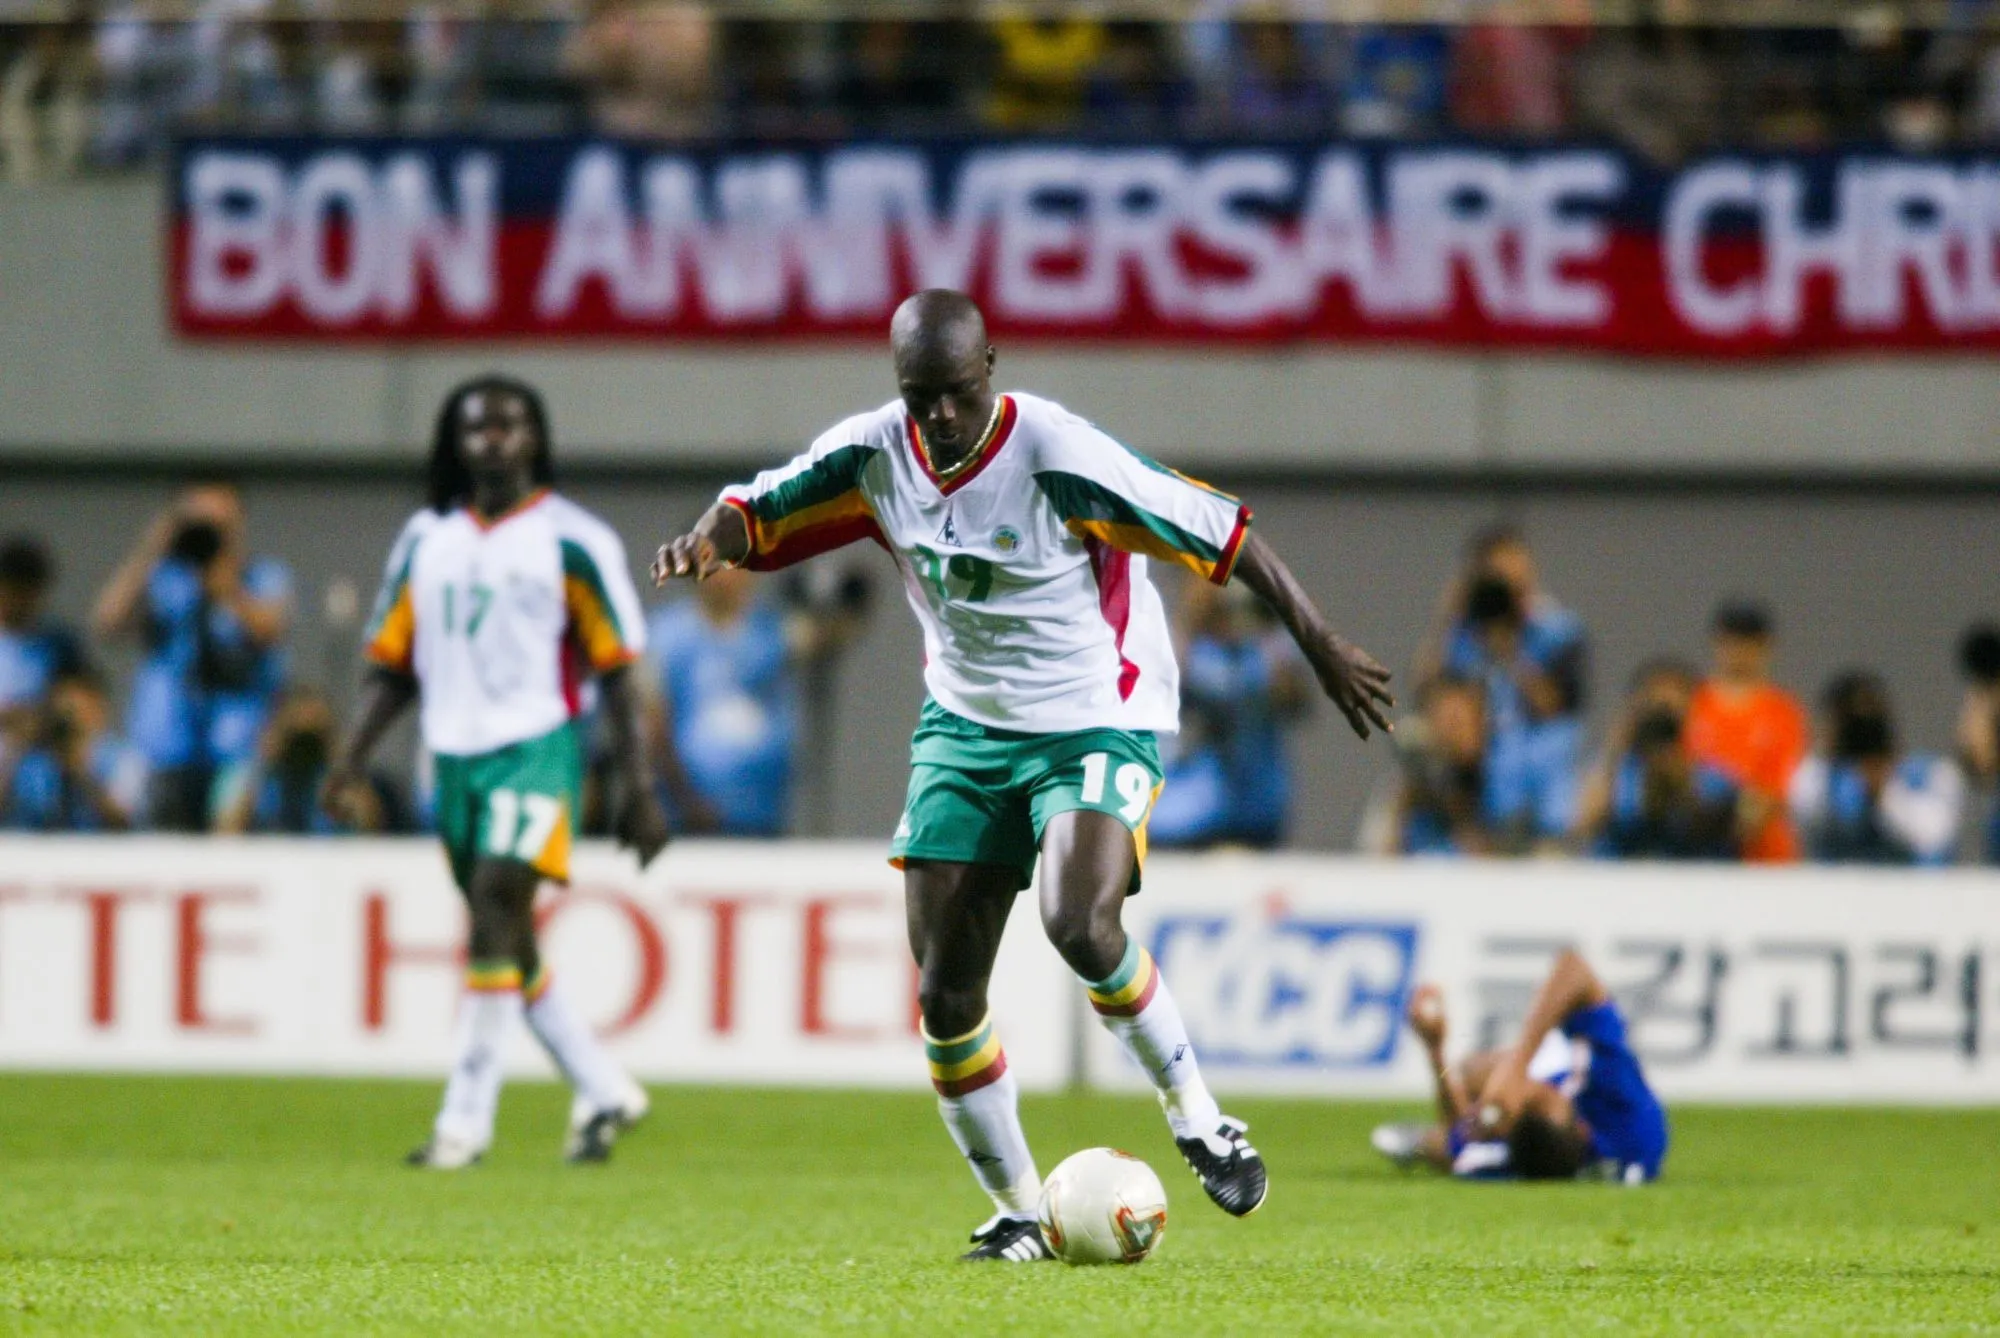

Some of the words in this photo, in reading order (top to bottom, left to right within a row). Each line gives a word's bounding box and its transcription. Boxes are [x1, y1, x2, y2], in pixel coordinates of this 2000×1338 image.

[184, 150, 498, 322] BON
[1660, 158, 2000, 336] CHRI
[443, 582, 496, 640] 17
[489, 786, 564, 862] 17
[1080, 751, 1151, 824] 19
[0, 882, 262, 1038] TE
[360, 884, 928, 1044] HOTE
